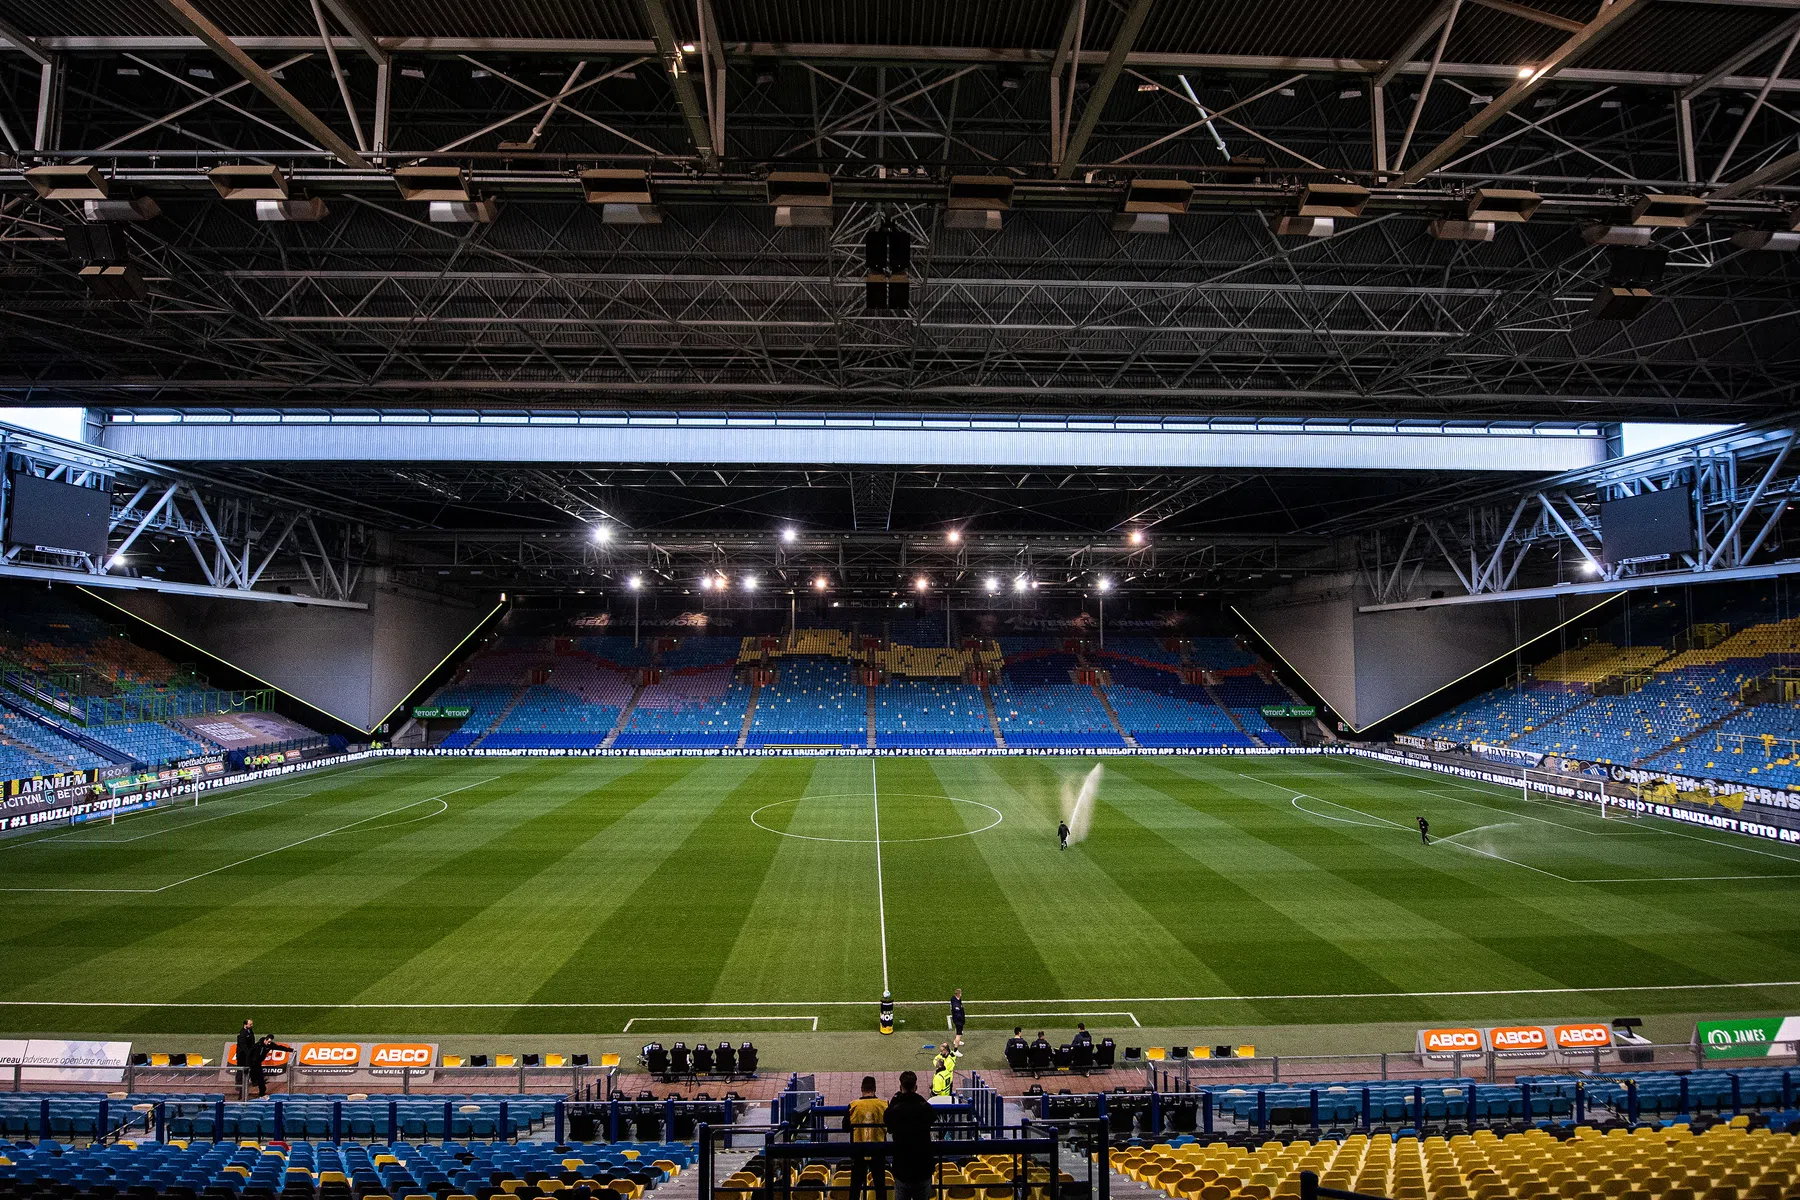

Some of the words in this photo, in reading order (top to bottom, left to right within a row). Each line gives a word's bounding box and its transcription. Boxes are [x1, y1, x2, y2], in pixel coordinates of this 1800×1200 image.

[396, 748, 411, 756] APP
[145, 780, 212, 801] SNAPPSHOT
[212, 778, 224, 788] #1
[224, 770, 263, 785] BRUILOFT
[263, 768, 282, 778] FOTO
[282, 764, 295, 774] APP
[1433, 764, 1482, 780] SNAPPSHOT
[1534, 782, 1556, 794] FOTO
[1557, 786, 1574, 797] APP
[10, 815, 27, 828] #1
[30, 802, 92, 824] BRUILOFT
[93, 798, 121, 812] FOTO
[122, 794, 142, 806] APP
[1577, 790, 1654, 813] SNAPPSHOT
[1655, 804, 1671, 817] #1
[1672, 808, 1739, 831] BRUILOFT
[1740, 820, 1778, 838] FOTO
[1429, 1034, 1478, 1046] ABCO
[1496, 1030, 1543, 1044] ABCO
[1560, 1028, 1606, 1042] ABCO
[1734, 1028, 1766, 1042] JAMES
[23, 1055, 58, 1064] adviseurs
[60, 1056, 95, 1066] openbare
[304, 1048, 357, 1060] ABCO
[374, 1049, 428, 1062] ABCO
